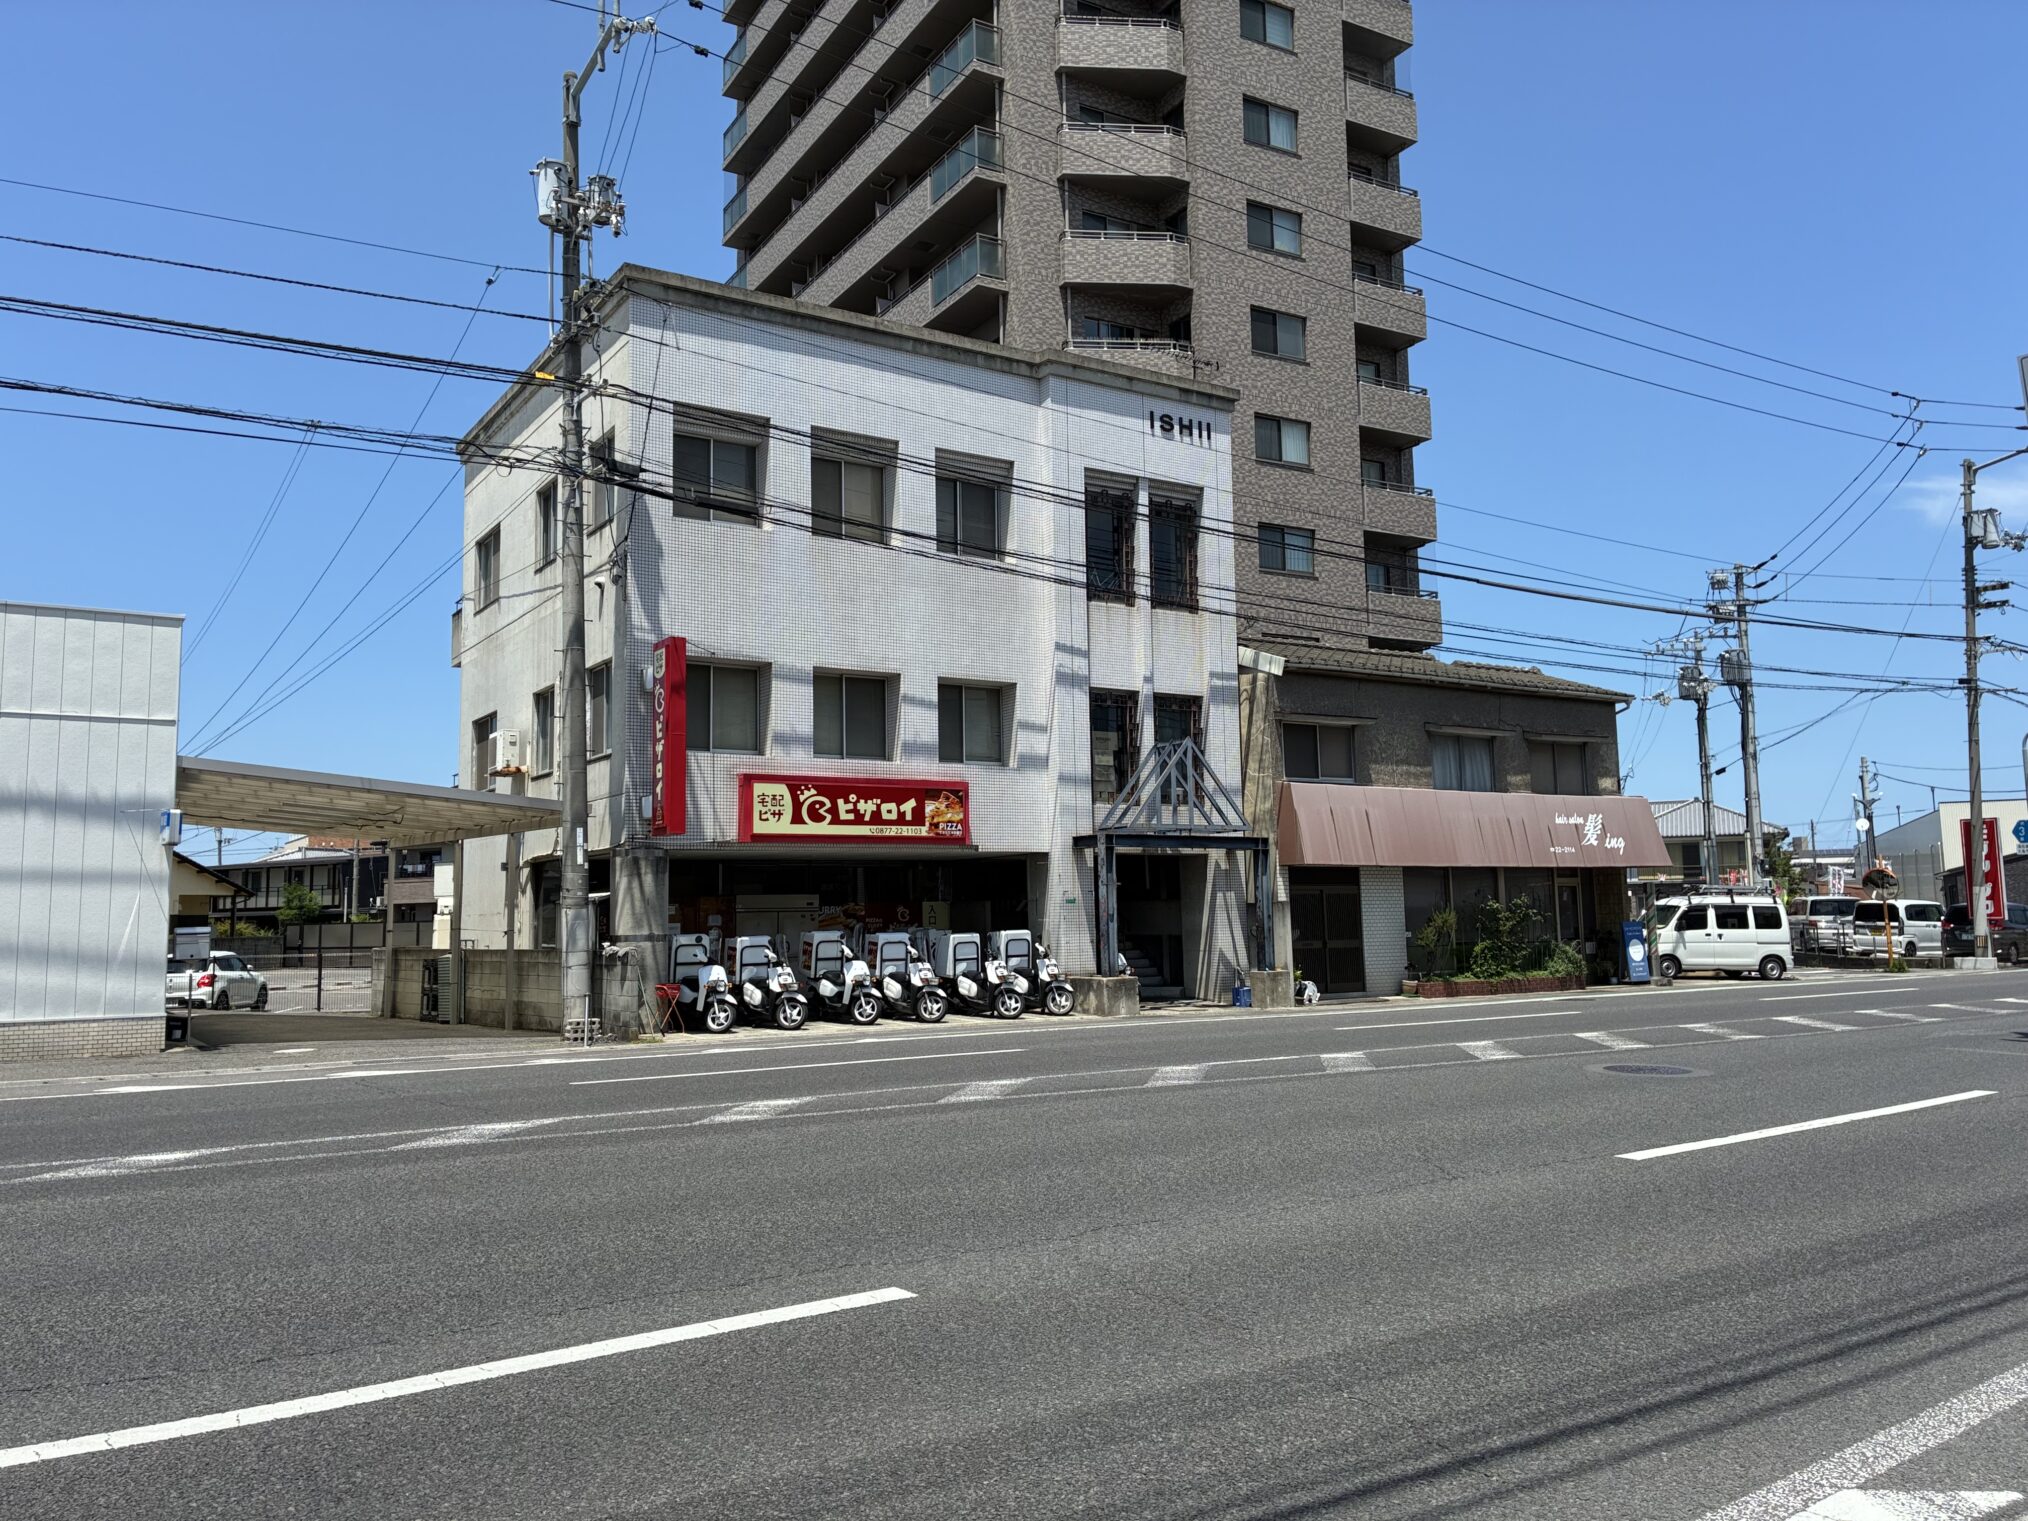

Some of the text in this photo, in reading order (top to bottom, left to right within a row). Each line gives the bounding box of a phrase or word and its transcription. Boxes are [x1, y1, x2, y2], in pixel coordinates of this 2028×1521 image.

[1150, 410, 1212, 441] ISHII
[656, 715, 665, 801] ピザロイ
[757, 792, 785, 808] 宅配
[836, 793, 918, 822] ピザロイ
[758, 808, 786, 823] ピザ
[875, 827, 923, 836] 0877-22-1103
[939, 822, 963, 832] PIZZA
[1580, 813, 1603, 846] 髪
[1604, 833, 1626, 856] ing
[928, 905, 937, 926] 入口
